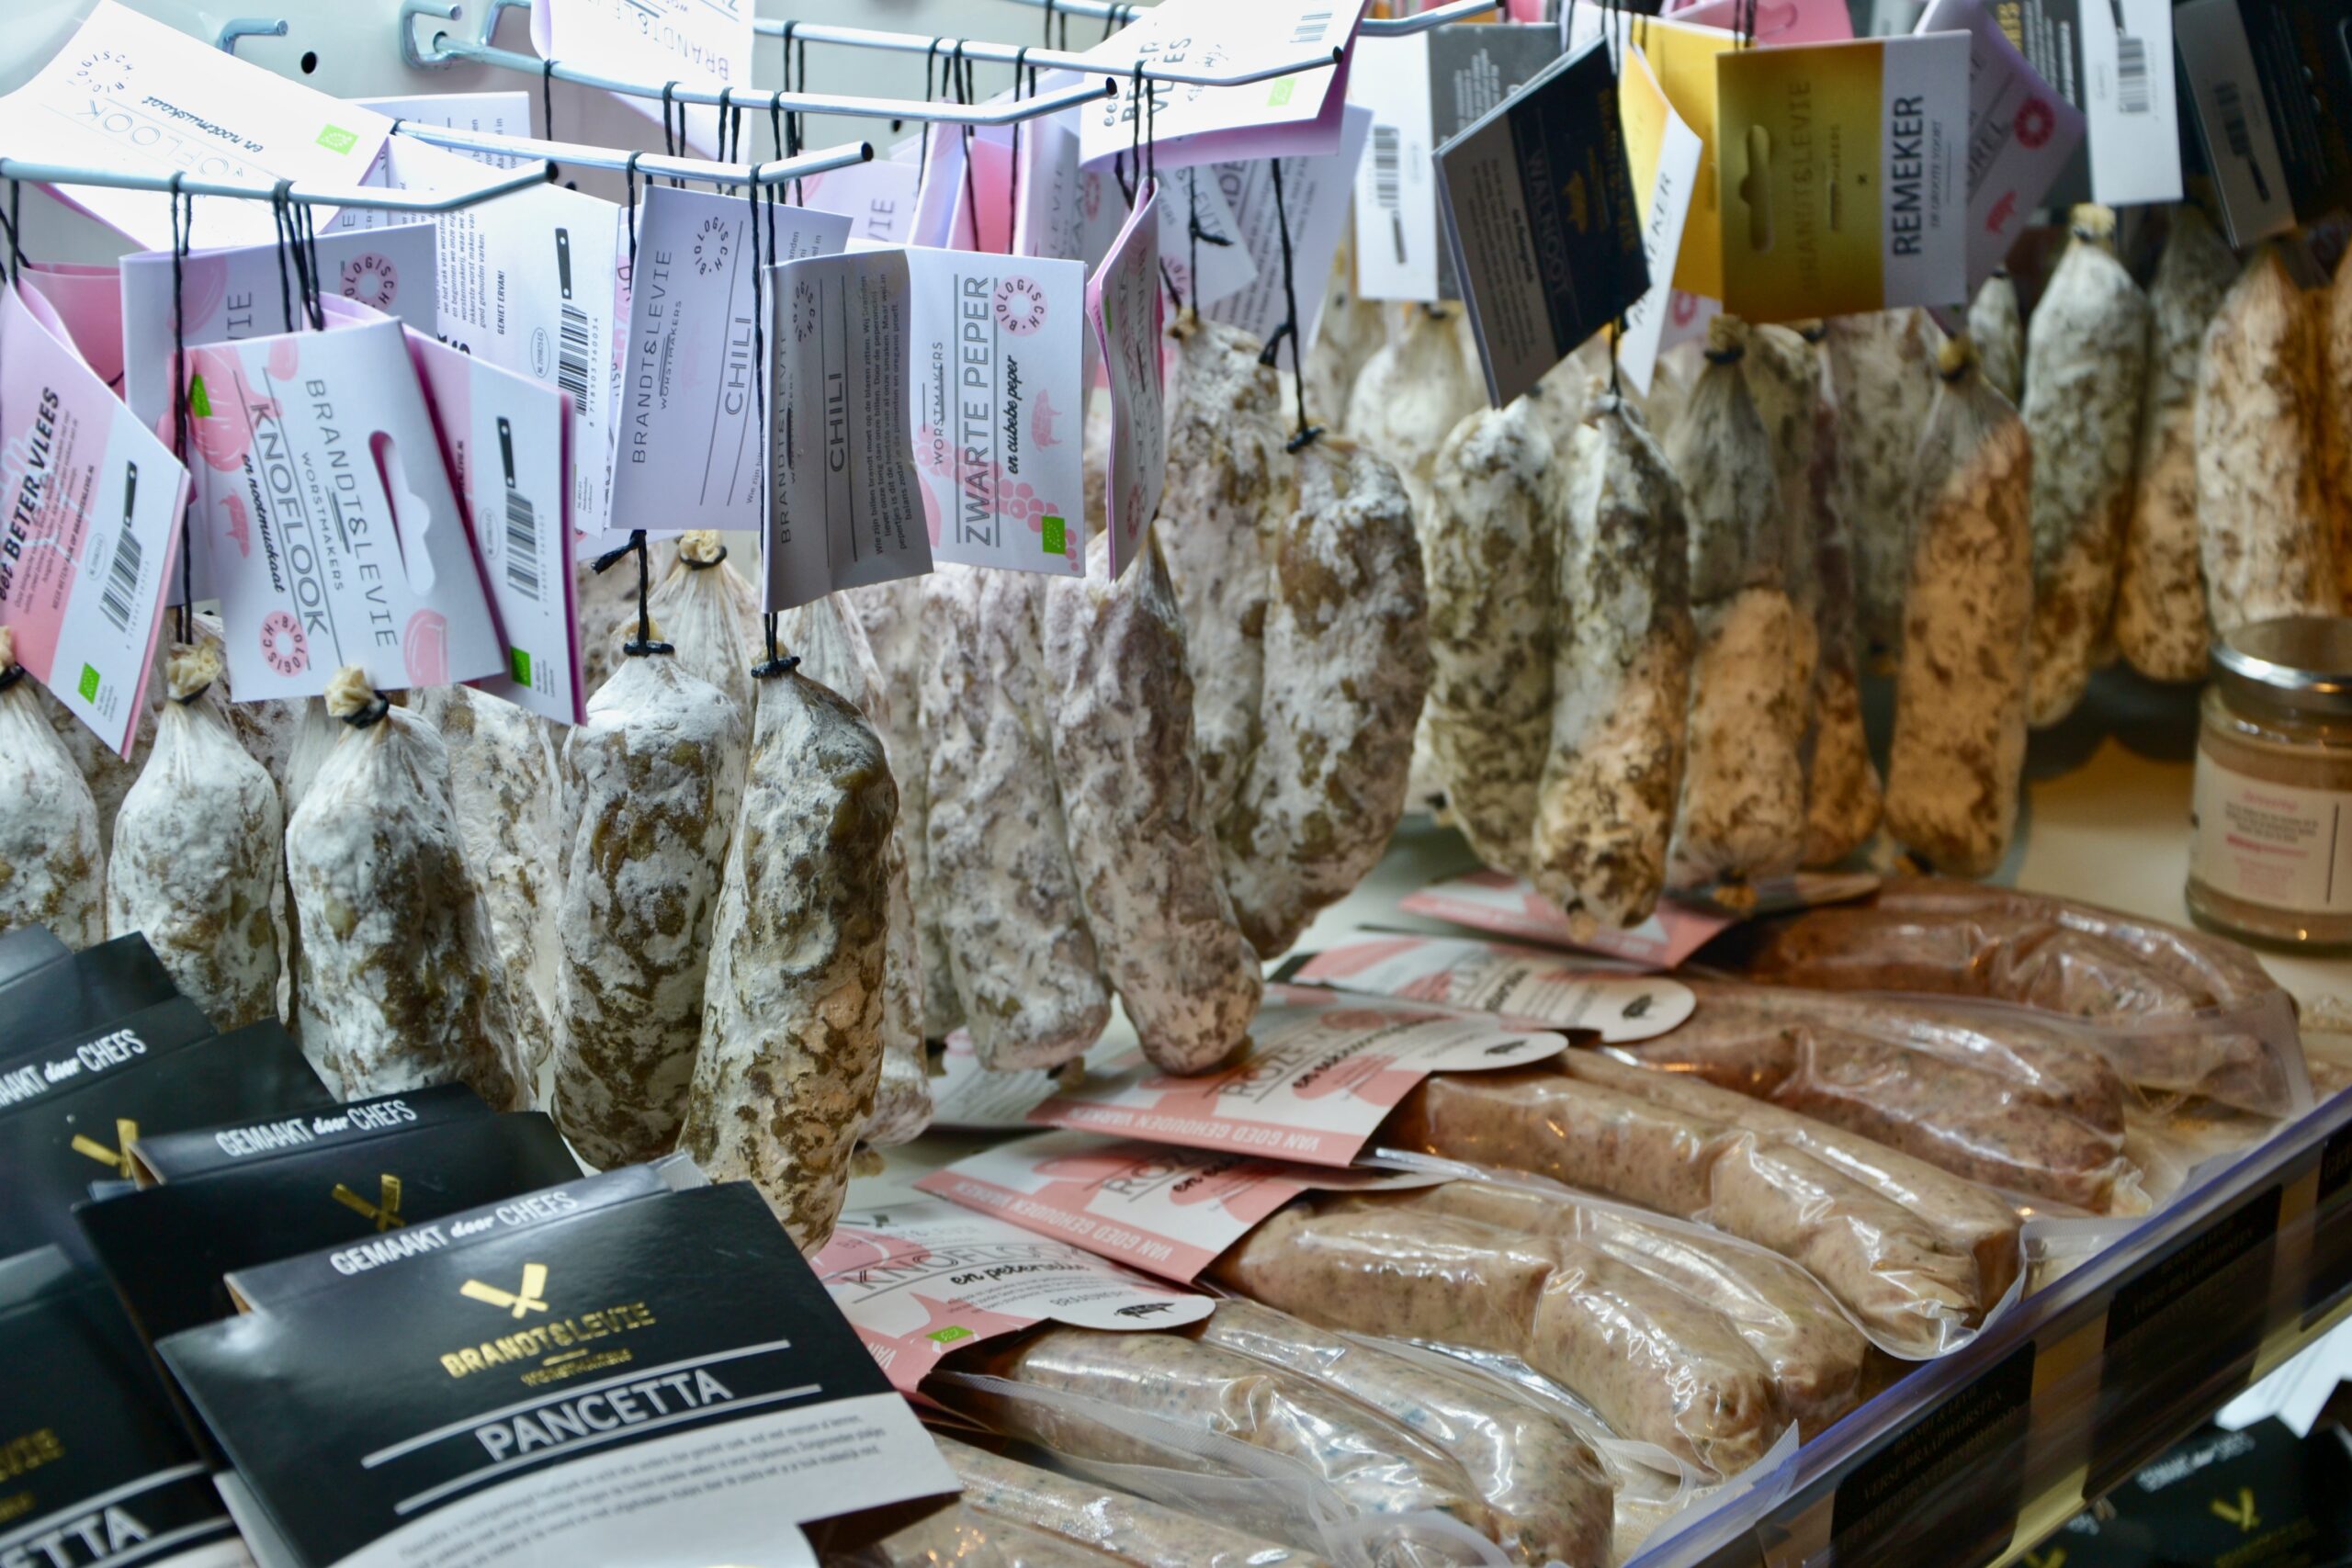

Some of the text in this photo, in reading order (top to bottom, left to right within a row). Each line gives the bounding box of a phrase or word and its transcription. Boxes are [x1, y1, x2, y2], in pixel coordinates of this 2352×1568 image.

[1122, 39, 1160, 122] BETR
[1149, 36, 1193, 121] VLES
[75, 99, 243, 176] OFLOOK
[141, 96, 264, 152] en nootmuskaat
[1893, 96, 1923, 256] REMEKER
[695, 216, 729, 276] BIOLOGISCH
[863, 318, 871, 333] Wij
[995, 278, 1045, 333] BIOLOGISCH
[631, 251, 673, 465] BRANDT&LEVIE
[725, 317, 752, 416] CHILI
[863, 336, 871, 366] zitten.
[872, 349, 880, 360] de
[892, 334, 900, 373] oregano
[873, 364, 881, 385] Door
[892, 375, 899, 386] en
[828, 373, 844, 472] CHILI
[865, 400, 871, 412] de
[865, 412, 873, 426] op
[883, 398, 889, 407] al
[891, 389, 899, 433] pimenton
[934, 341, 944, 465] WORSTMAKERS
[964, 276, 991, 547] ZWARTE PEPER
[1003, 355, 1023, 476] en cubebe peper
[882, 431, 893, 464] heetste
[1, 474, 42, 562] BETER
[28, 386, 60, 472] VLEES
[866, 456, 876, 486] brandt
[876, 464, 886, 484] tong
[887, 467, 894, 478] de
[888, 480, 896, 493] dit
[896, 461, 906, 485] zodat
[250, 402, 329, 635] KNOFLOOK
[300, 451, 345, 591] WORSTMAKERS
[305, 378, 399, 647] BRANDT&LEVIE
[868, 490, 877, 515] billen
[890, 496, 898, 504] is
[900, 488, 912, 520] balans
[241, 453, 287, 594] en nootmuskaat
[871, 519, 881, 535] zijn
[874, 537, 883, 554] Wie
[882, 512, 891, 536] liever
[893, 507, 907, 549] pepertjes
[262, 615, 305, 675] BIOLOGISCH
[75, 1028, 148, 1073] CHEFS
[215, 1100, 418, 1157] GEMAAKT door CHEFS
[329, 1190, 579, 1277] GEMAAKT door CHEFS
[950, 1269, 985, 1285] en
[439, 1301, 658, 1379] BRANDT&LEVIE
[474, 1368, 735, 1461] PANCETTA
